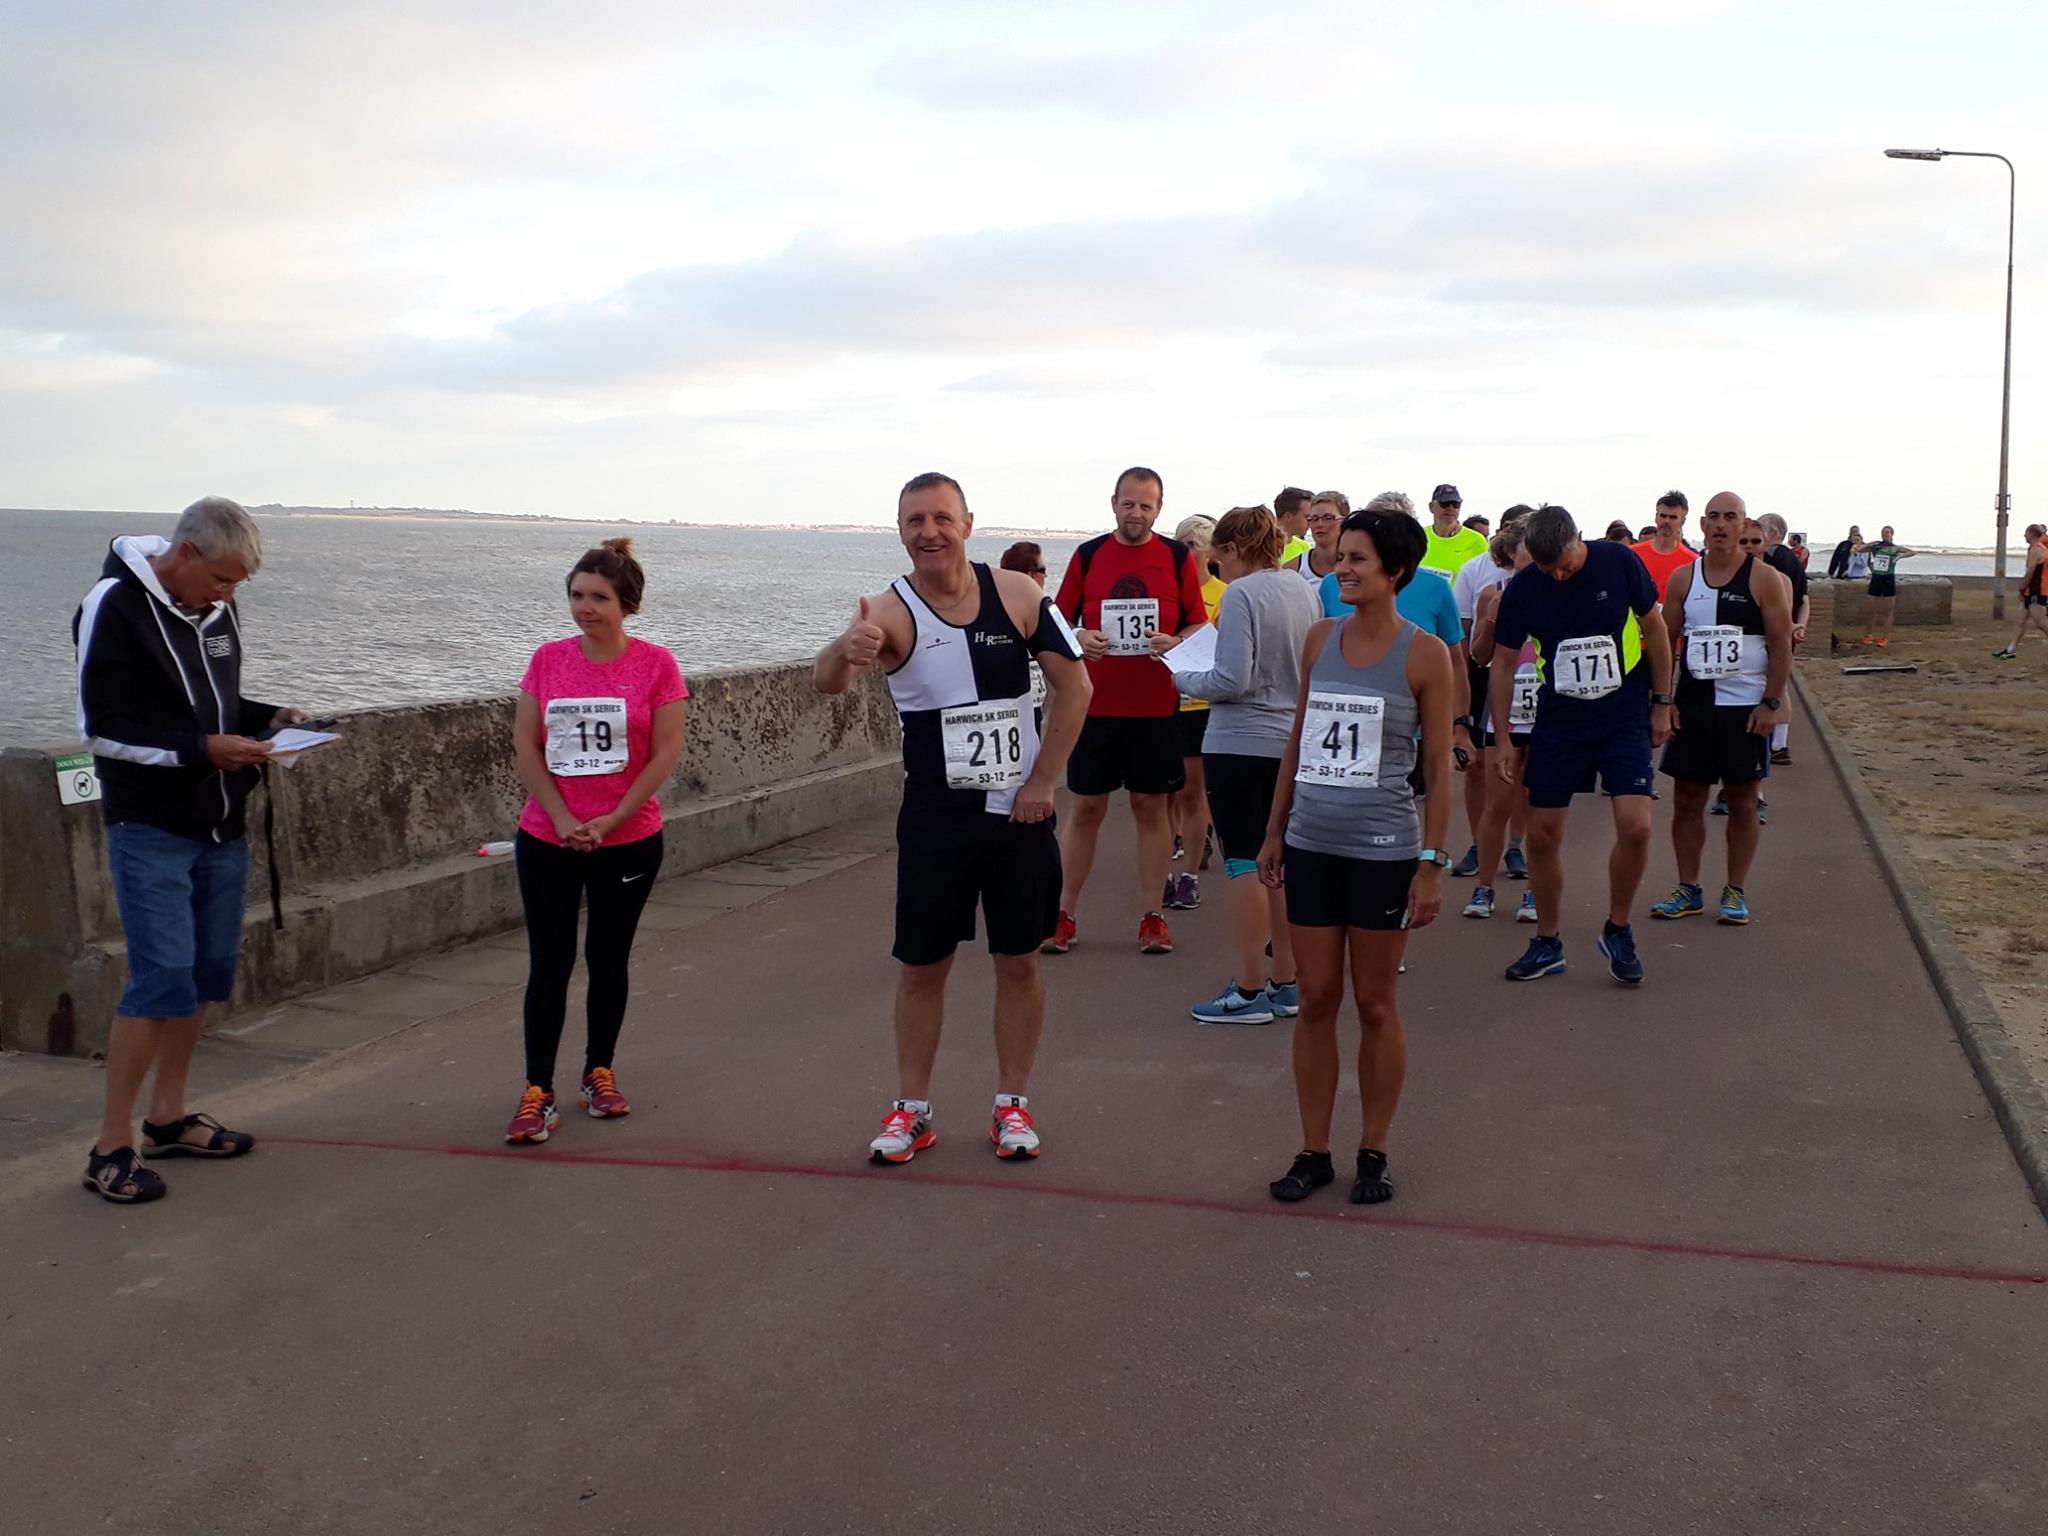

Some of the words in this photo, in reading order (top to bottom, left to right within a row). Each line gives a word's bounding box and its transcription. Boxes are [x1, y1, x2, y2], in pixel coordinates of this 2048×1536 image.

[1116, 615, 1155, 639] 135
[1701, 640, 1739, 664] 113
[1571, 653, 1613, 682] 171
[1578, 686, 1600, 694] 53-12
[582, 705, 592, 713] 5K
[594, 704, 621, 713] SERIES
[1335, 702, 1347, 712] 5K
[1347, 703, 1378, 714] SERIES
[945, 714, 983, 725] HARWICH
[984, 712, 995, 722] 5K
[996, 709, 1019, 720] SERIES
[1521, 712, 1536, 720] 53-1
[576, 720, 612, 752] 19
[1322, 721, 1359, 760] 41
[967, 726, 1020, 767] 218
[574, 759, 599, 768] 53-12
[978, 771, 1005, 783] 53-12
[1319, 765, 1346, 778] 53-12
